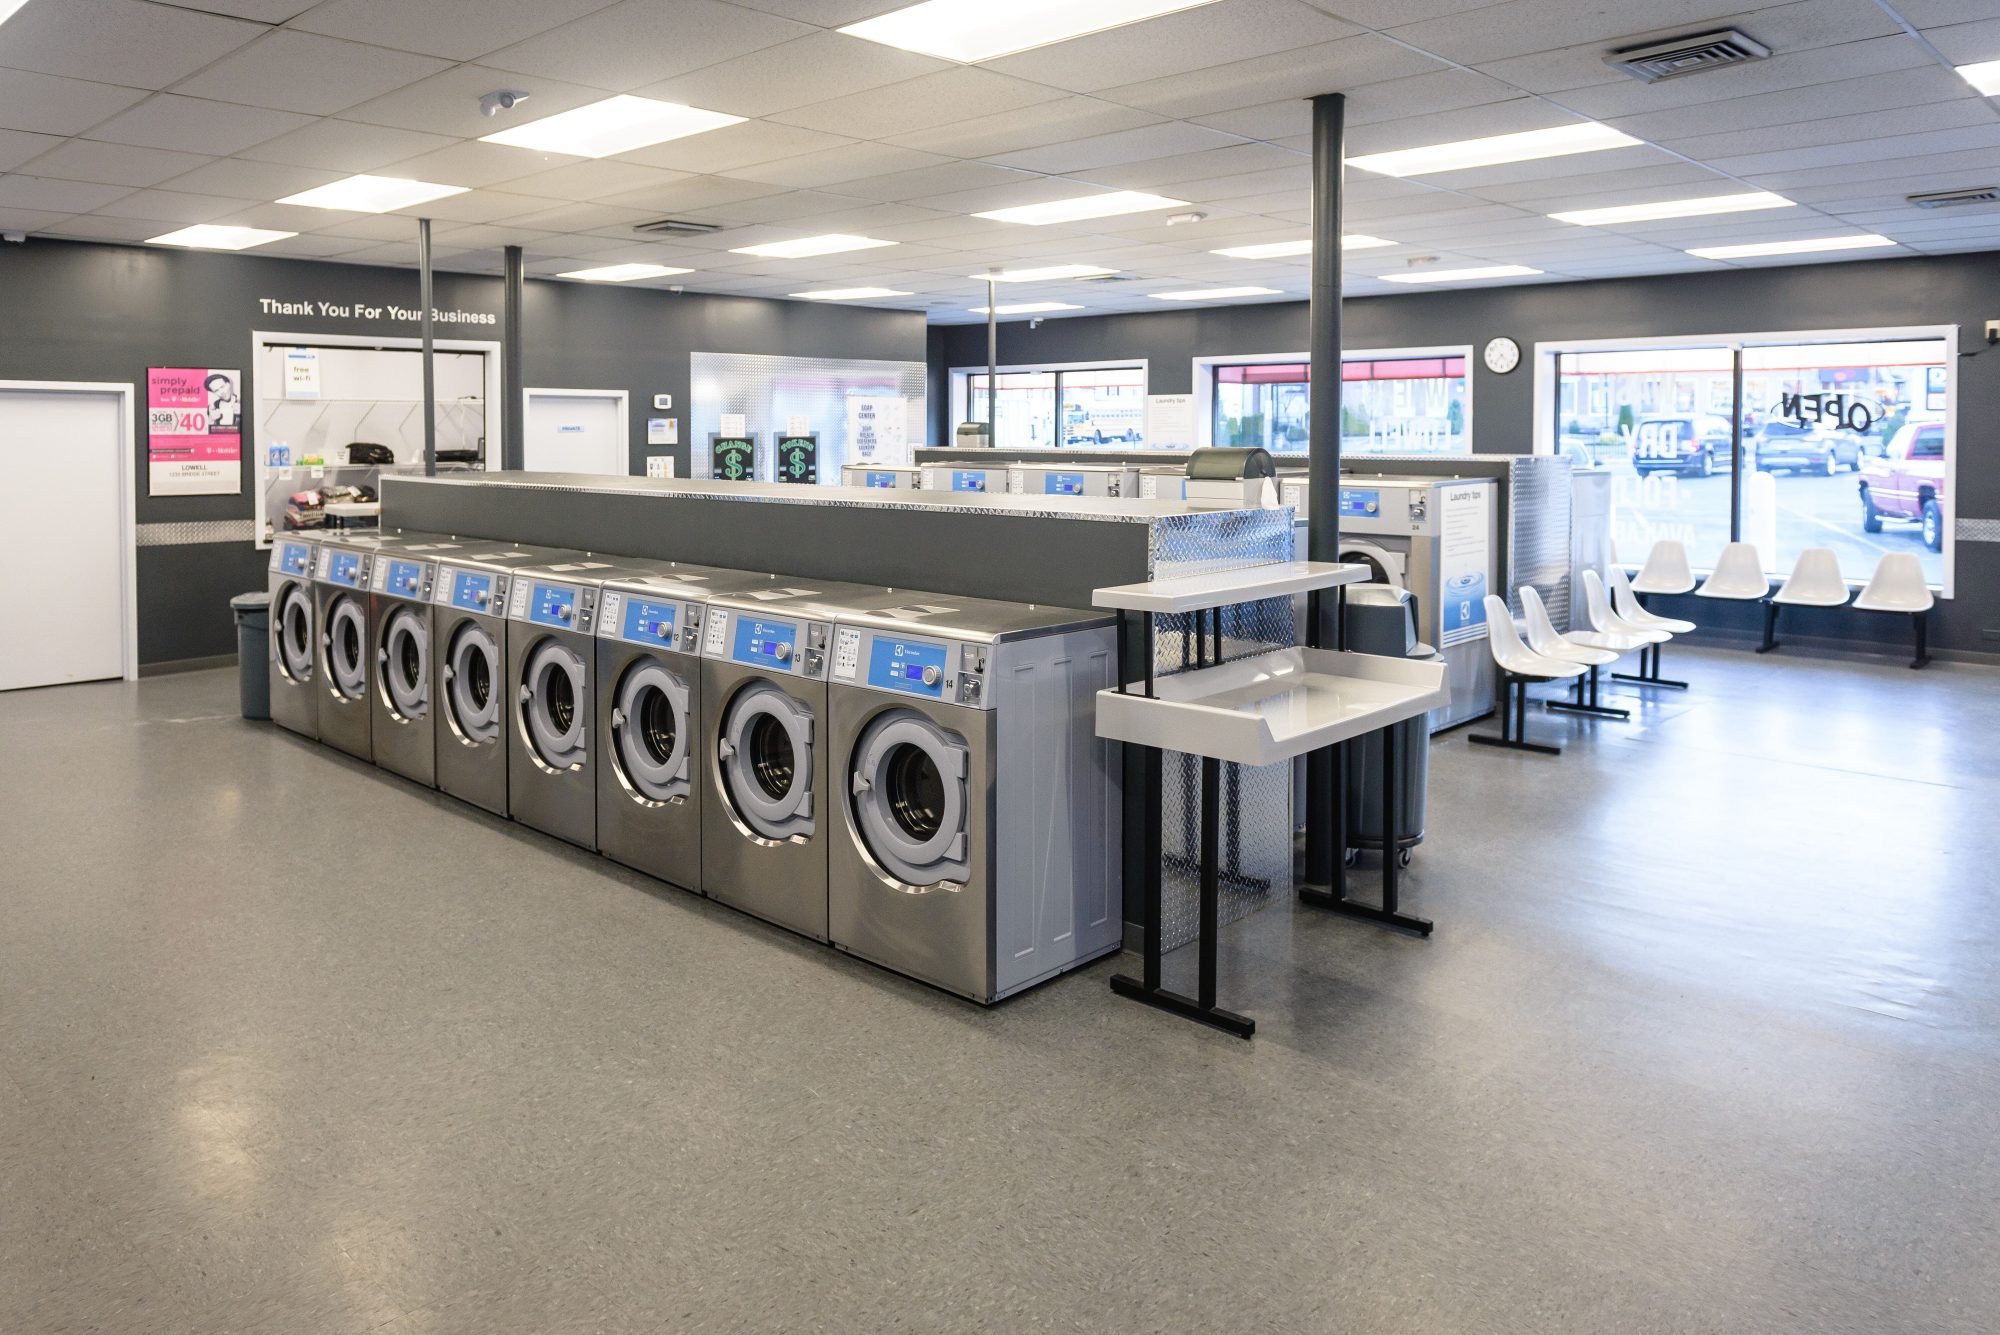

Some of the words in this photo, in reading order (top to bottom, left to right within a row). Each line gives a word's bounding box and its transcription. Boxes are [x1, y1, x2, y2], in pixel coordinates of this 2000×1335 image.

[259, 298, 314, 316] Thank
[317, 302, 350, 318] You
[354, 304, 382, 319] For
[387, 306, 423, 321] Your
[431, 308, 496, 325] Business
[151, 376, 187, 386] simply
[160, 386, 200, 395] prepaid
[152, 413, 173, 423] 3GB
[715, 440, 753, 454] CHANGE
[780, 439, 814, 452] TOKENS
[1450, 491, 1471, 501] Laundry
[673, 633, 680, 641] 12
[794, 653, 801, 662] 13
[945, 679, 953, 689] 14
